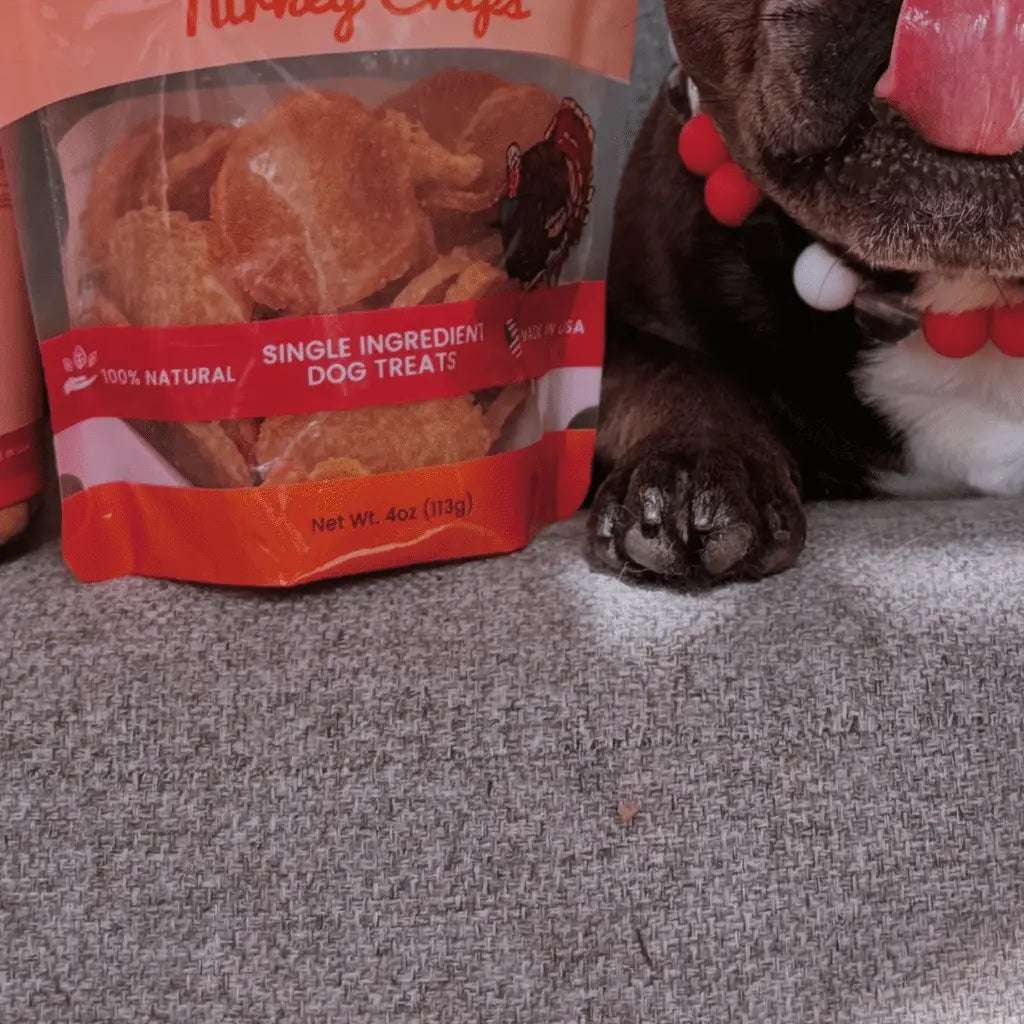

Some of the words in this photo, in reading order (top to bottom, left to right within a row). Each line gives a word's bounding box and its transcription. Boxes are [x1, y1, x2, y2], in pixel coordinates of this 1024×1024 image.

[262, 337, 352, 365] SINGLE
[360, 323, 484, 356] INGREDIENT
[101, 367, 141, 386] 100%
[144, 365, 236, 387] NATURAL
[308, 361, 367, 387] DOG
[374, 351, 457, 379] TREATS
[311, 515, 345, 533] Net
[350, 510, 380, 528] Wt.
[385, 506, 417, 522] 4oz
[423, 491, 473, 521] (113g)
